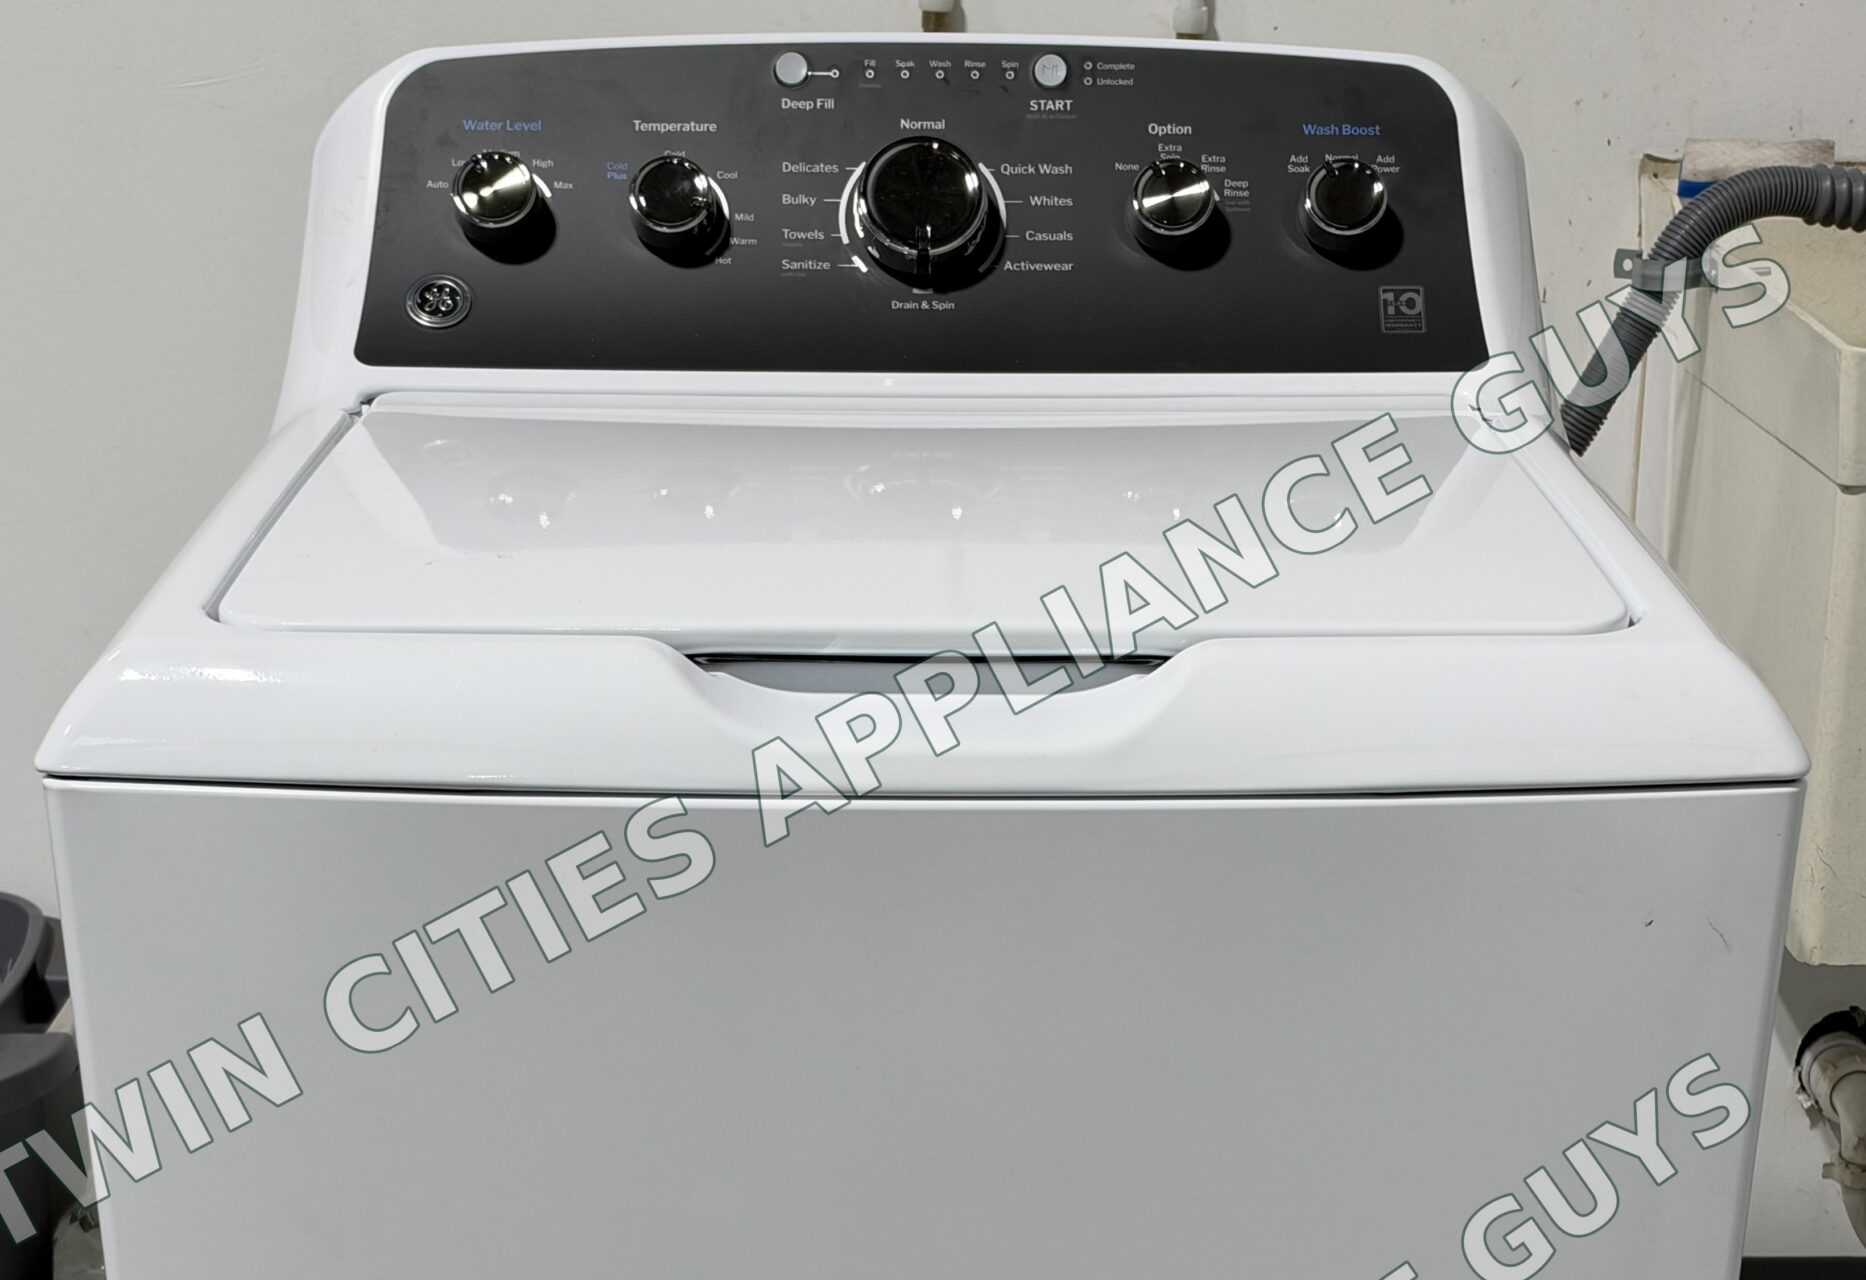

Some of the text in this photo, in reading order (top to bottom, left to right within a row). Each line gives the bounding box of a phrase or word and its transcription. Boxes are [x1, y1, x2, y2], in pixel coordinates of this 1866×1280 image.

[864, 59, 877, 67] Fill
[964, 60, 986, 68] Rinse
[1001, 60, 1019, 69] Spin
[1096, 62, 1135, 71] Complete
[1096, 78, 1133, 86] Unlocked
[781, 98, 834, 111] Deep Fill
[1029, 100, 1073, 111] START
[463, 119, 542, 131] Water Level
[633, 120, 717, 134] Temperature
[900, 118, 945, 130] Normal
[1148, 123, 1192, 136] Option
[1302, 124, 1381, 136] Wash Boost
[1158, 143, 1182, 152] Extra
[452, 159, 466, 167] Lo
[1201, 155, 1226, 163] Extra
[1290, 155, 1308, 163] Add
[1376, 155, 1395, 163] Add
[532, 159, 555, 169] High
[606, 162, 628, 170] Cold
[782, 162, 840, 173] Delicates
[1115, 163, 1139, 171] None
[1201, 164, 1226, 173] Rinse
[1001, 164, 1073, 176] Quick Wash
[1287, 165, 1311, 173] Soak
[606, 172, 628, 180] Plus
[717, 171, 738, 180] Cool
[426, 180, 449, 189] Auto
[553, 181, 574, 189] Max
[1224, 179, 1249, 189] Deep
[1224, 189, 1249, 197] Rinse
[782, 194, 817, 206] Bulky
[1029, 196, 1073, 207] Whites
[734, 213, 755, 222] Mild
[782, 229, 825, 240] Towels
[1025, 230, 1073, 241] Casuals
[730, 237, 758, 246] Warm
[715, 257, 732, 265] Hot
[782, 259, 831, 271] Sanitize
[1004, 260, 1074, 271] Activewear
[891, 300, 955, 311] Drain & Spin
